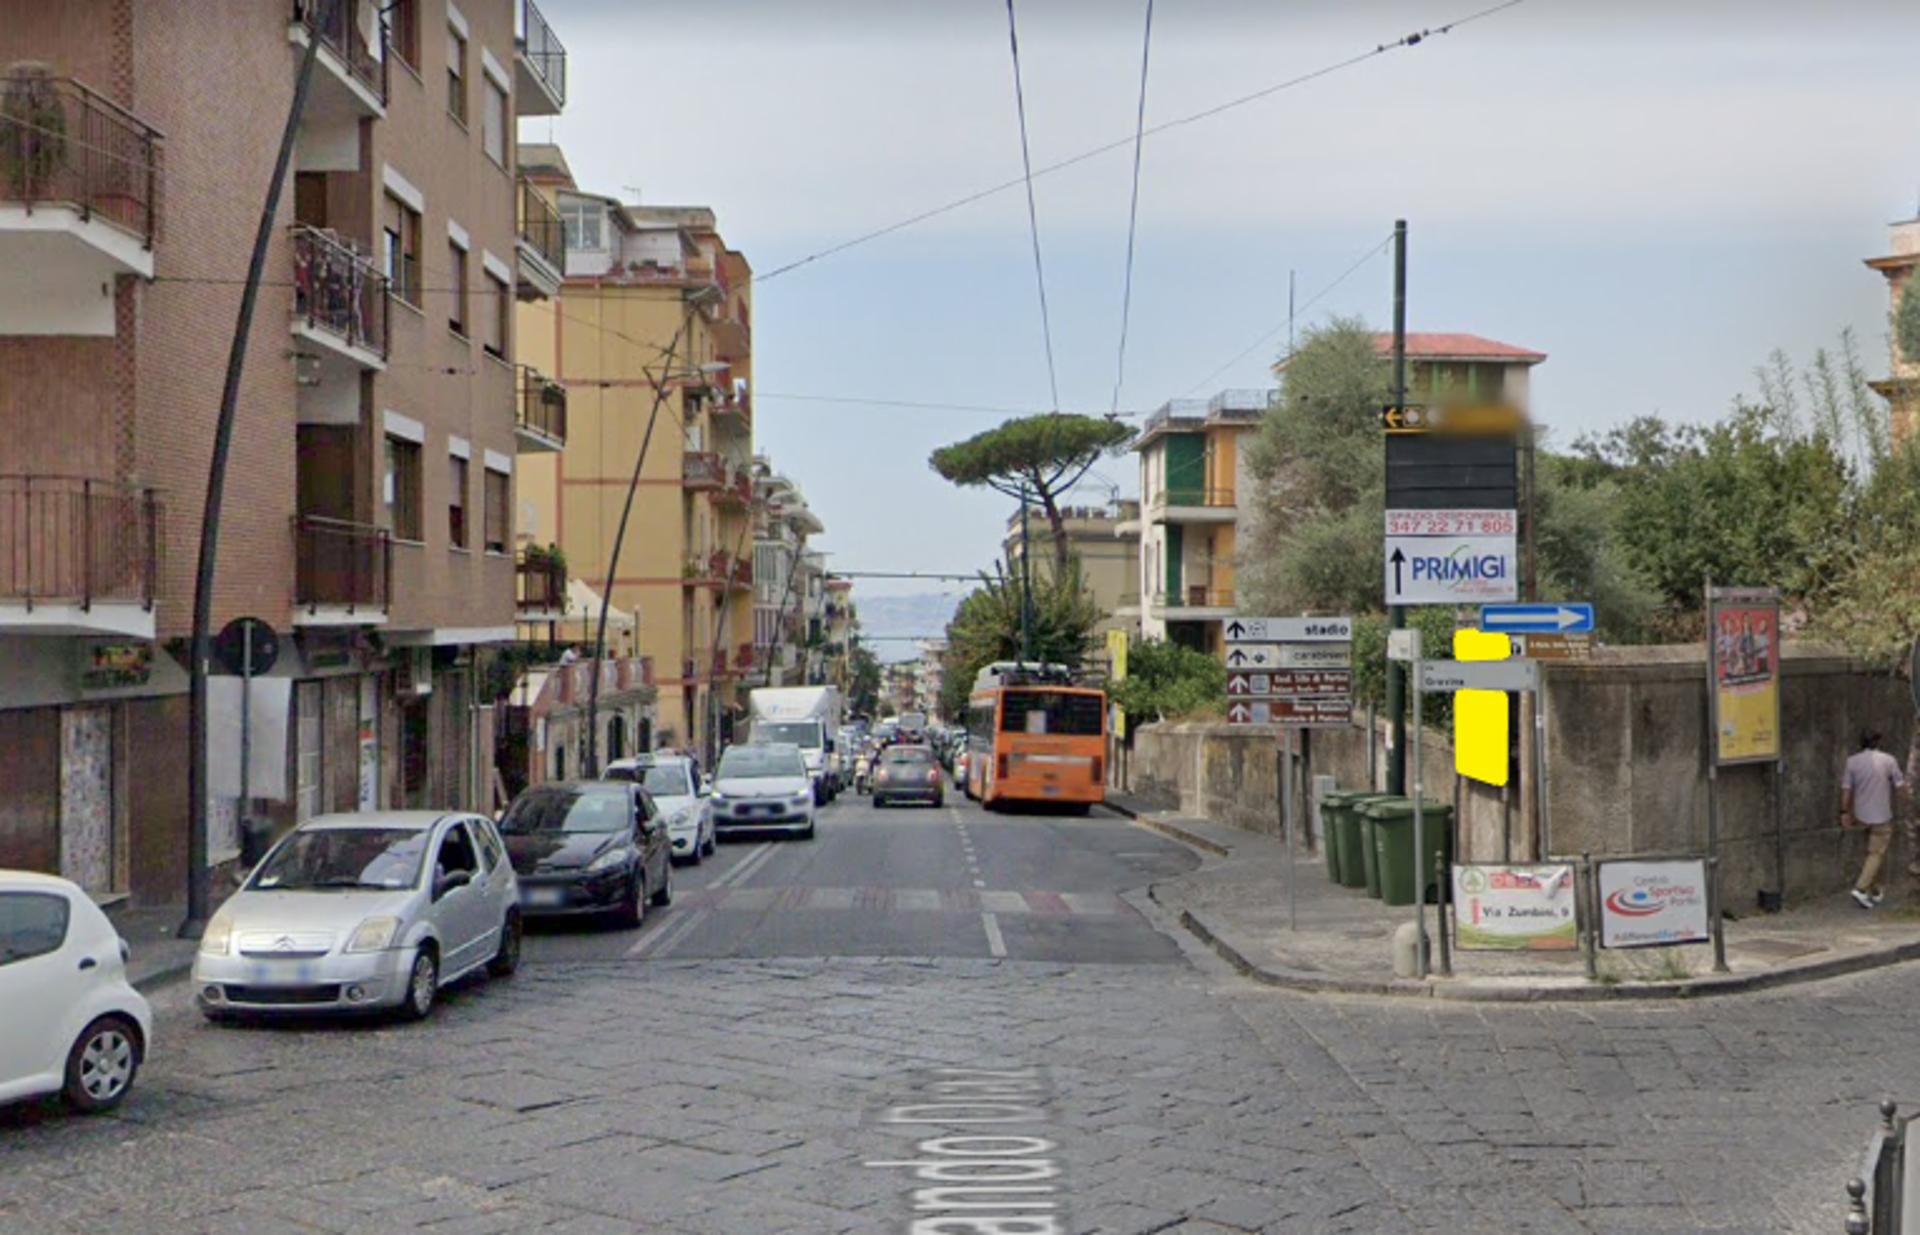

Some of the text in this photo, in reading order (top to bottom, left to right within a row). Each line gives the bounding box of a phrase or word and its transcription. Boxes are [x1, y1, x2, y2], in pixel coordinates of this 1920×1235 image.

[1390, 520, 1514, 533] 347 22 71 805
[1412, 554, 1505, 580] PRIMIGI
[1304, 624, 1349, 636] stadio
[1424, 677, 1465, 687] Gravina
